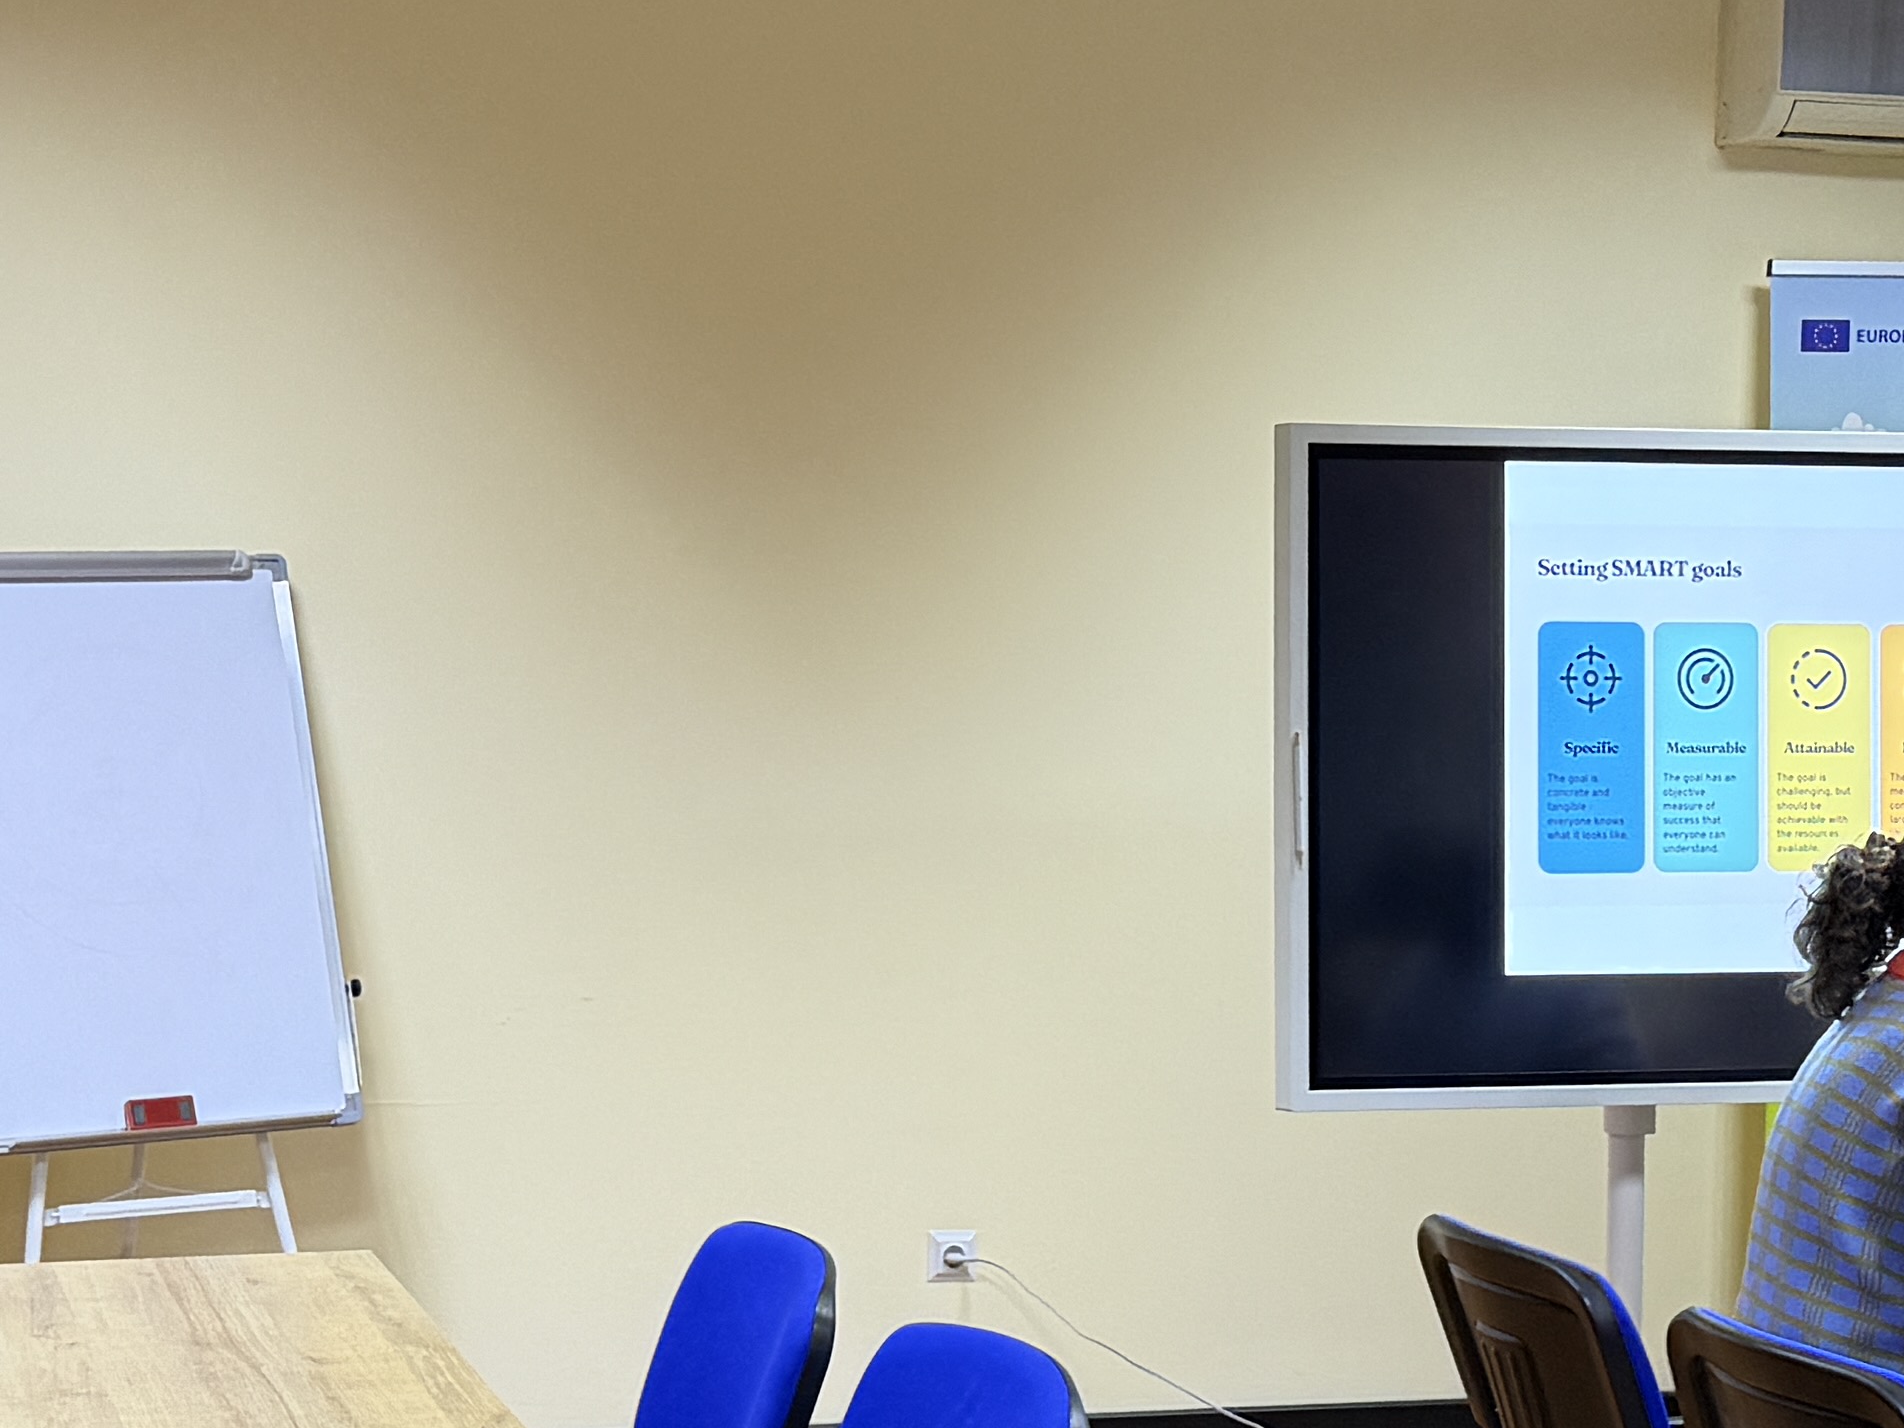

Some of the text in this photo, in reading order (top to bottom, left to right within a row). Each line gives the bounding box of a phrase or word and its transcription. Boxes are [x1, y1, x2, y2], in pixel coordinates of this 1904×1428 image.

[1537, 558, 1742, 583] Setting SMART goals
[1564, 741, 1619, 757] Specific
[1666, 741, 1747, 754] Measurable
[1784, 741, 1855, 754] Attainable
[1663, 772, 1680, 782] The
[1683, 773, 1703, 784] goal
[1777, 772, 1826, 783] The goal is
[1777, 801, 1822, 810] should be
